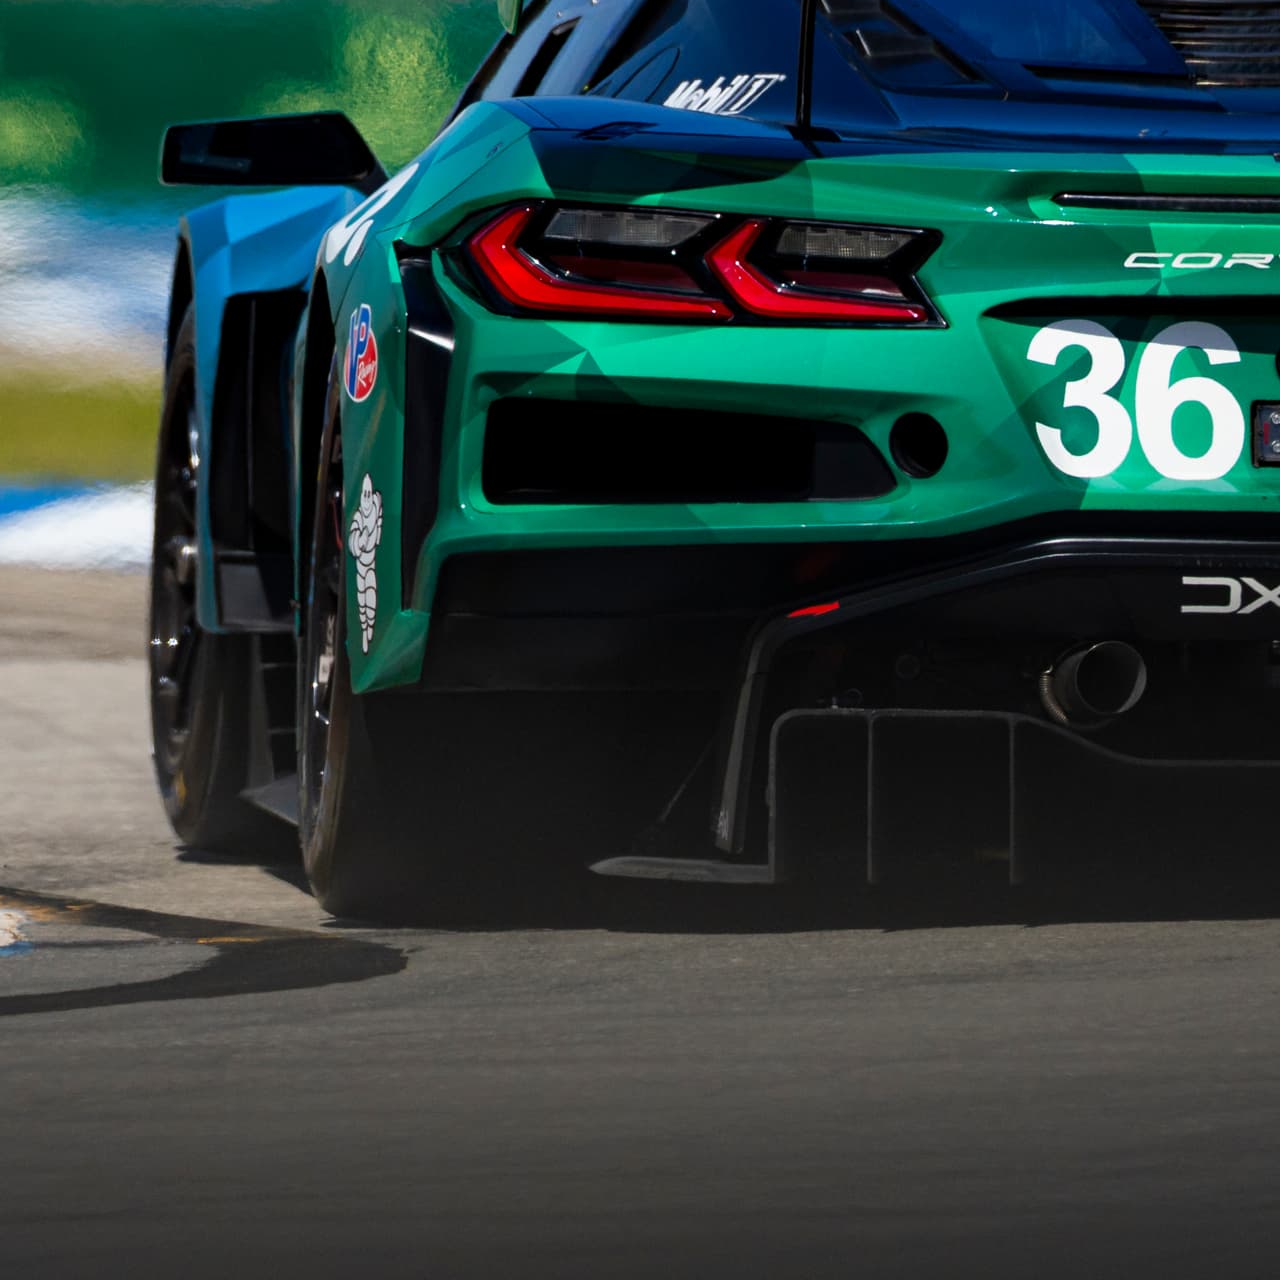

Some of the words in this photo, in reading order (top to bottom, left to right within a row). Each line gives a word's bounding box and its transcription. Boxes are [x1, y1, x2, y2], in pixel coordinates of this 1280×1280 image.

[662, 74, 750, 115] Mobil
[347, 303, 372, 400] VP
[1026, 318, 1246, 481] 36
